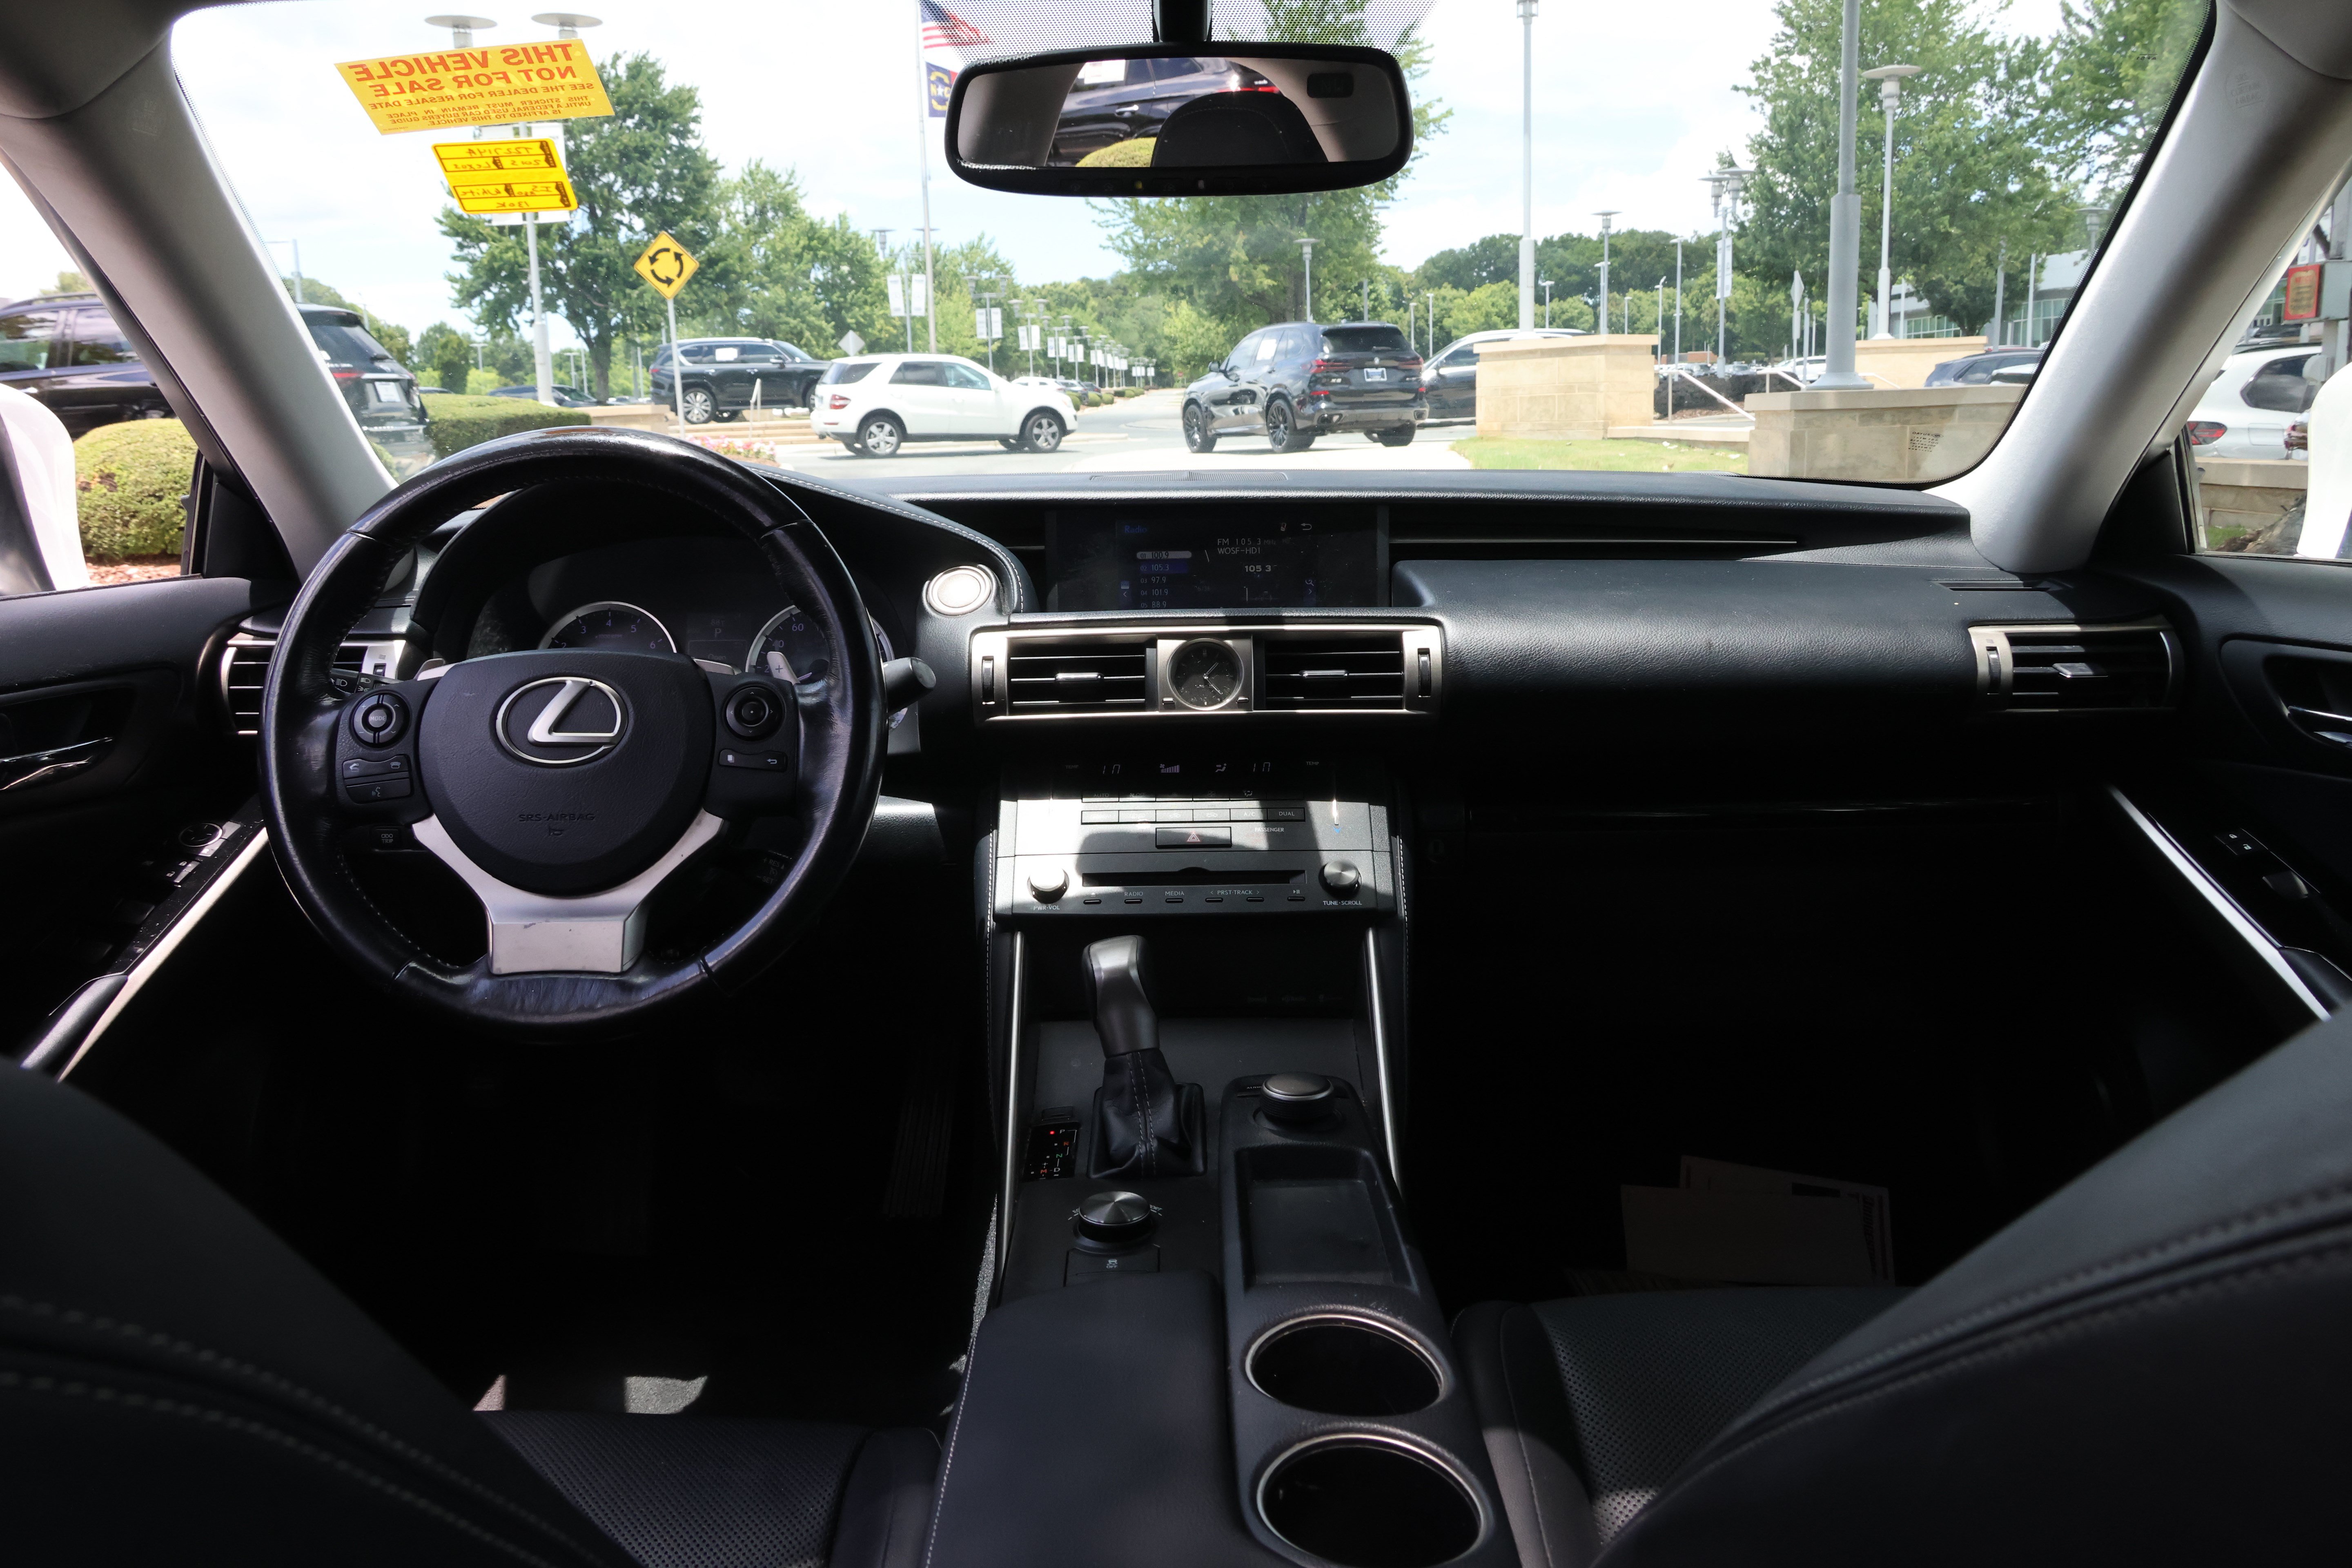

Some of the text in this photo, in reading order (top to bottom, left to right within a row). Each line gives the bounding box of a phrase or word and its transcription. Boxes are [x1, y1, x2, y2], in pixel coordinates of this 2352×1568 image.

[1124, 525, 1147, 533] Radio
[630, 625, 637, 633] 5
[791, 623, 804, 632] 60
[715, 628, 722, 638] P
[650, 641, 656, 649] 6
[768, 859, 780, 867] RES
[762, 875, 775, 885] SET
